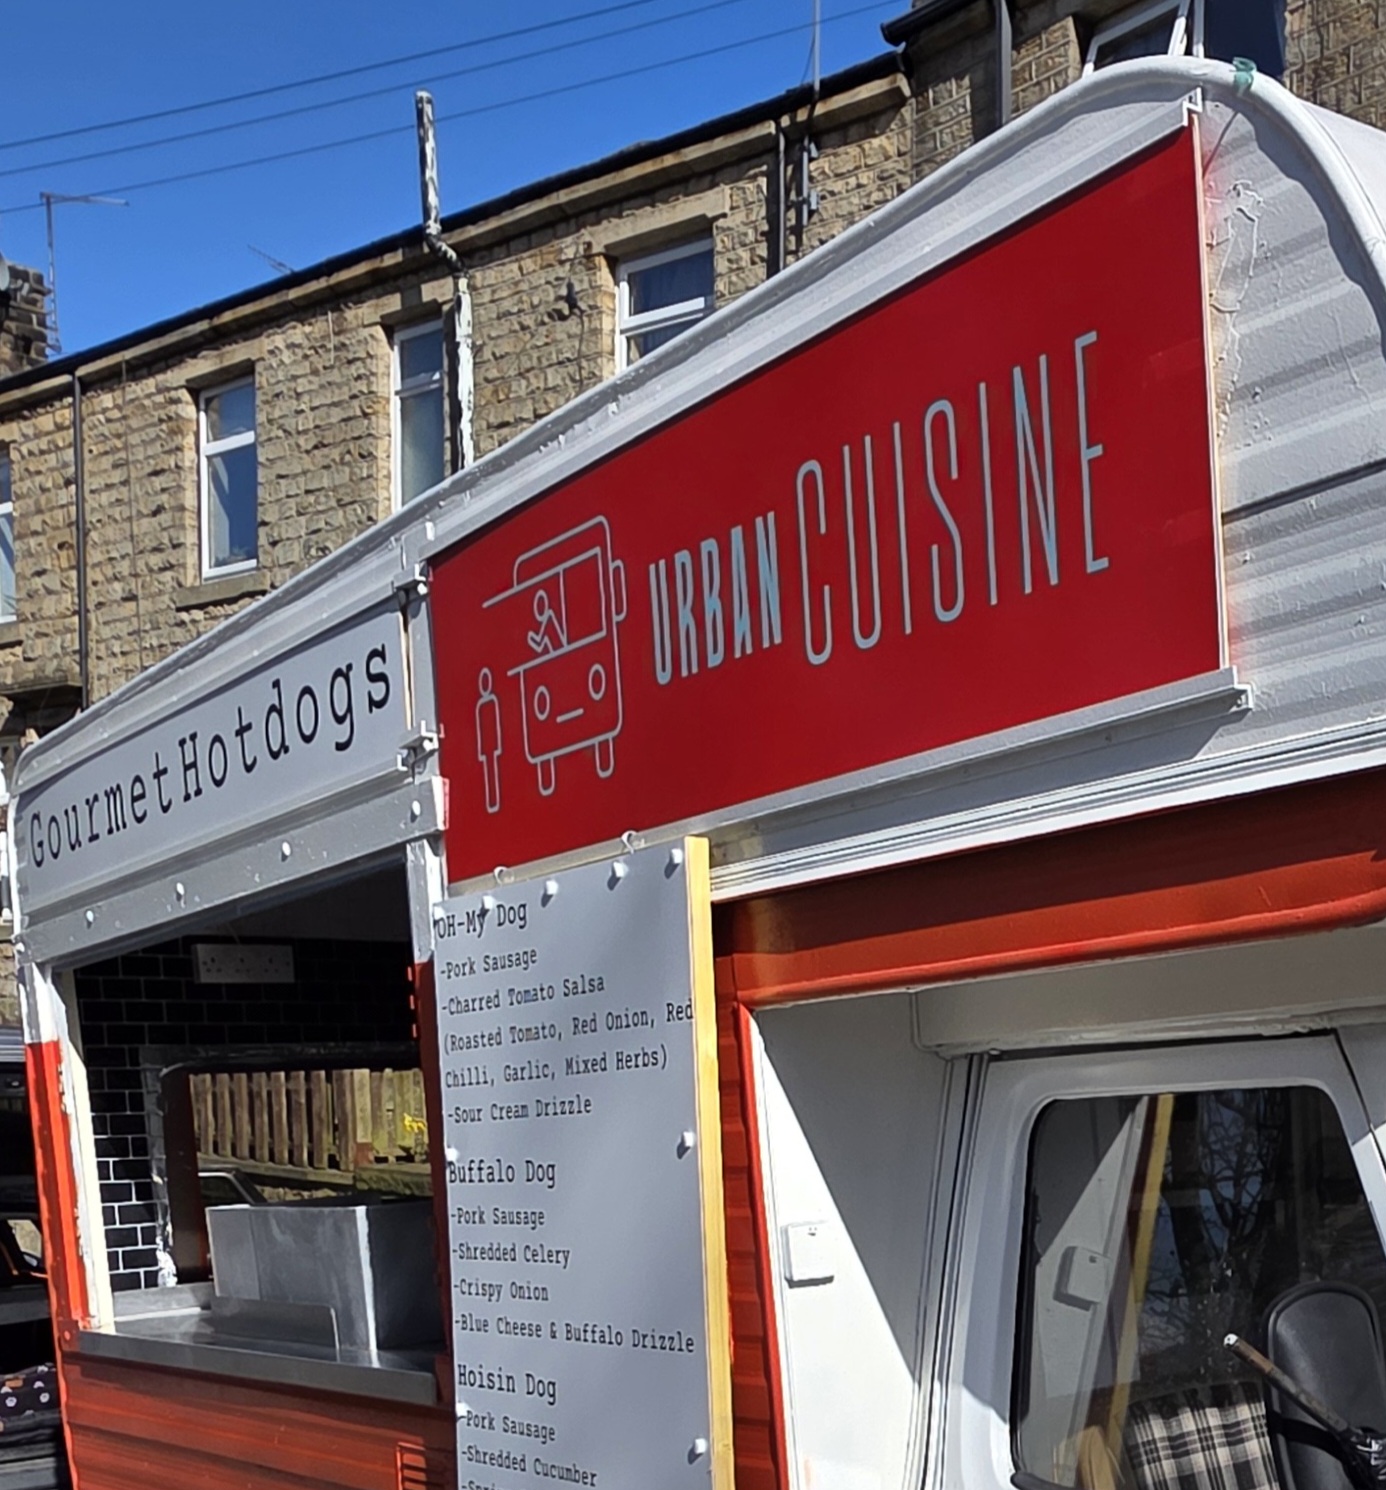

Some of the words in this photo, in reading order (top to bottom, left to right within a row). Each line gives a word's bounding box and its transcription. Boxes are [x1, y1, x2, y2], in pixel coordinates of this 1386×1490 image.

[649, 511, 782, 686] URBAN
[794, 330, 1110, 666] CUISINE
[437, 908, 486, 939] OH-My
[497, 903, 527, 930] Dog
[440, 956, 476, 980] -Pork
[483, 949, 537, 972] Sausage
[441, 989, 501, 1016] -Charred
[508, 982, 555, 1008] Tomato
[563, 974, 605, 996] Salsa
[443, 1025, 503, 1055] (Roasted
[509, 1019, 563, 1044] Tomato,
[572, 1012, 598, 1036] Red
[606, 1006, 656, 1030] Onion,
[666, 998, 695, 1022] Red
[445, 1067, 495, 1089] Chilli,
[504, 1060, 555, 1083] Garlic,
[565, 1052, 608, 1075] Mixed
[616, 1044, 668, 1070] Herbs)
[447, 1103, 483, 1124] -Sour
[491, 1098, 529, 1120] Cream
[536, 1095, 592, 1116] Drizzle
[448, 1159, 515, 1184] Buffalo
[525, 1160, 556, 1189] Dog
[451, 1206, 486, 1225] -Pork
[493, 1208, 545, 1230] Sausage
[452, 1243, 517, 1263] -Shredded
[524, 1245, 571, 1269] Celery
[454, 1279, 503, 1302] -Crispy
[510, 1281, 549, 1301] Onion
[455, 1314, 489, 1334] -Blue
[496, 1317, 543, 1339] Cheese
[550, 1321, 557, 1339] &
[565, 1323, 624, 1347] Buffalo
[632, 1329, 695, 1354] Drizzle
[458, 1364, 516, 1394] Hoisin
[526, 1373, 557, 1406] Dog
[503, 1416, 555, 1445] Sausage
[462, 1445, 527, 1474] -Shredded
[534, 1457, 598, 1488] Cucumber
